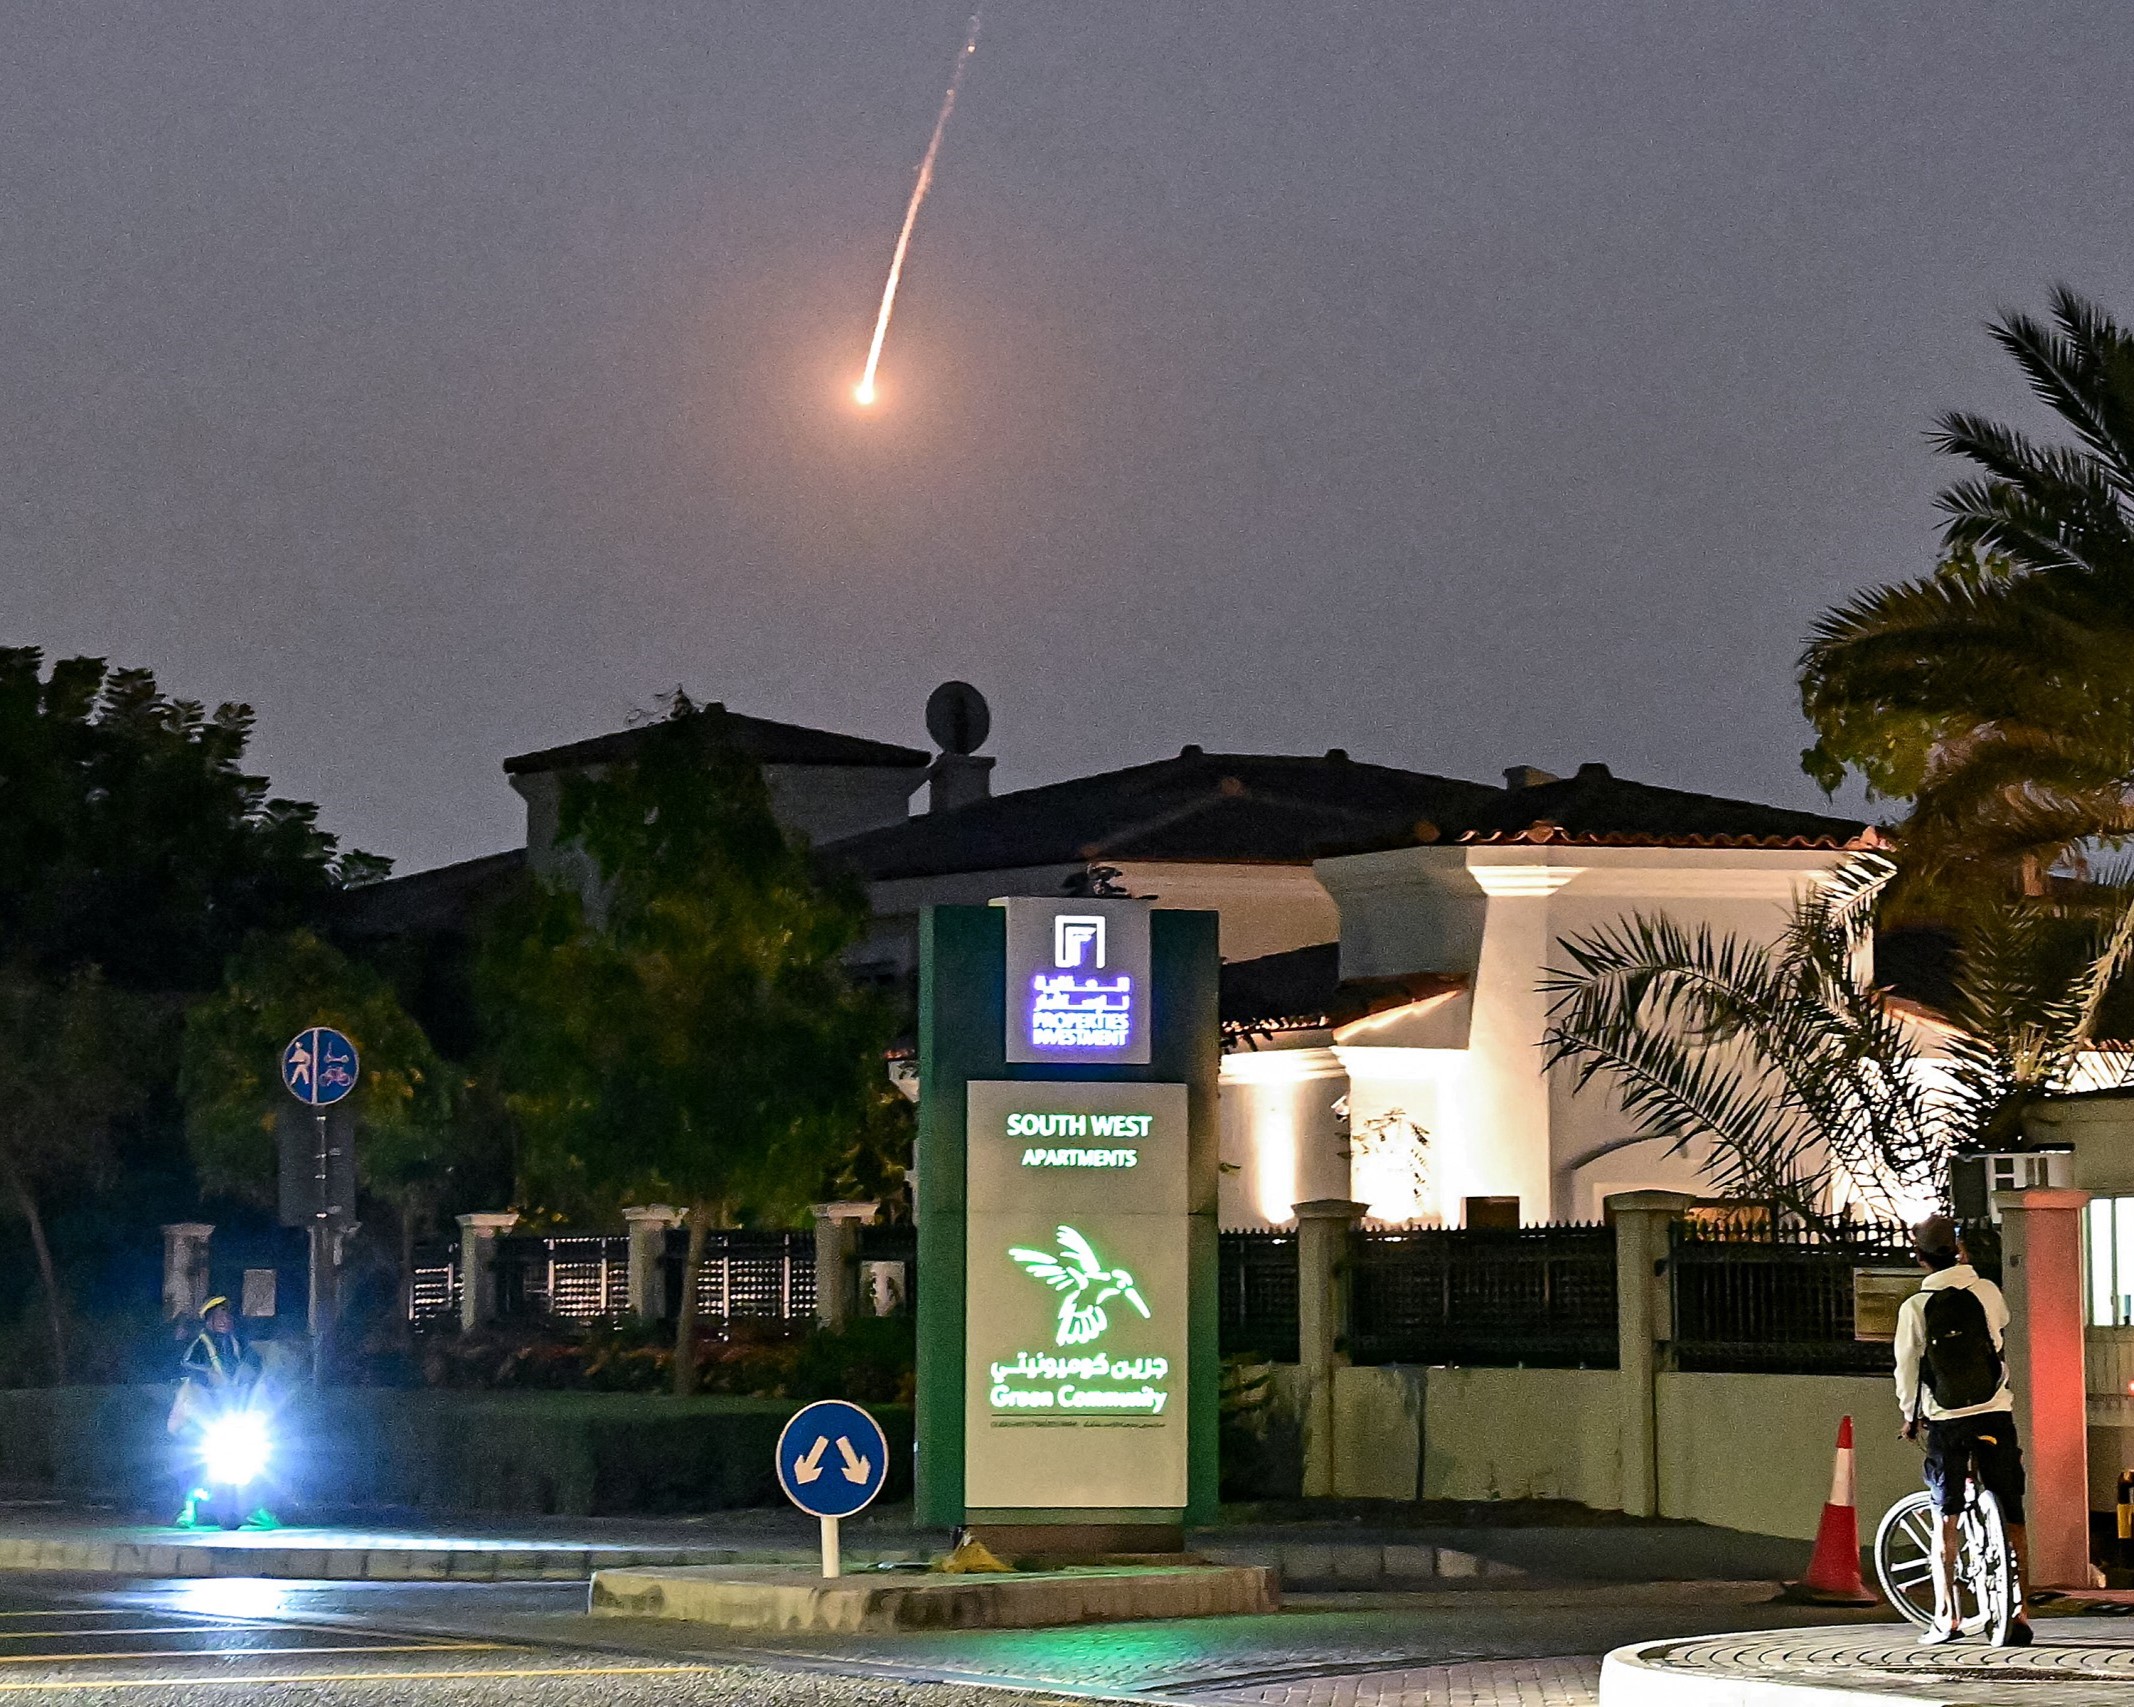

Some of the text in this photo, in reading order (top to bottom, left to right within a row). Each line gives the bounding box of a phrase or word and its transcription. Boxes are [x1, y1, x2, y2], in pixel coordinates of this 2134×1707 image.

[1032, 1012, 1130, 1029] PROPERTIES
[1006, 1113, 1153, 1137] SOUTH WEST
[1021, 1148, 1138, 1168] APARTMENTS
[989, 1384, 1168, 1414] Green Community
